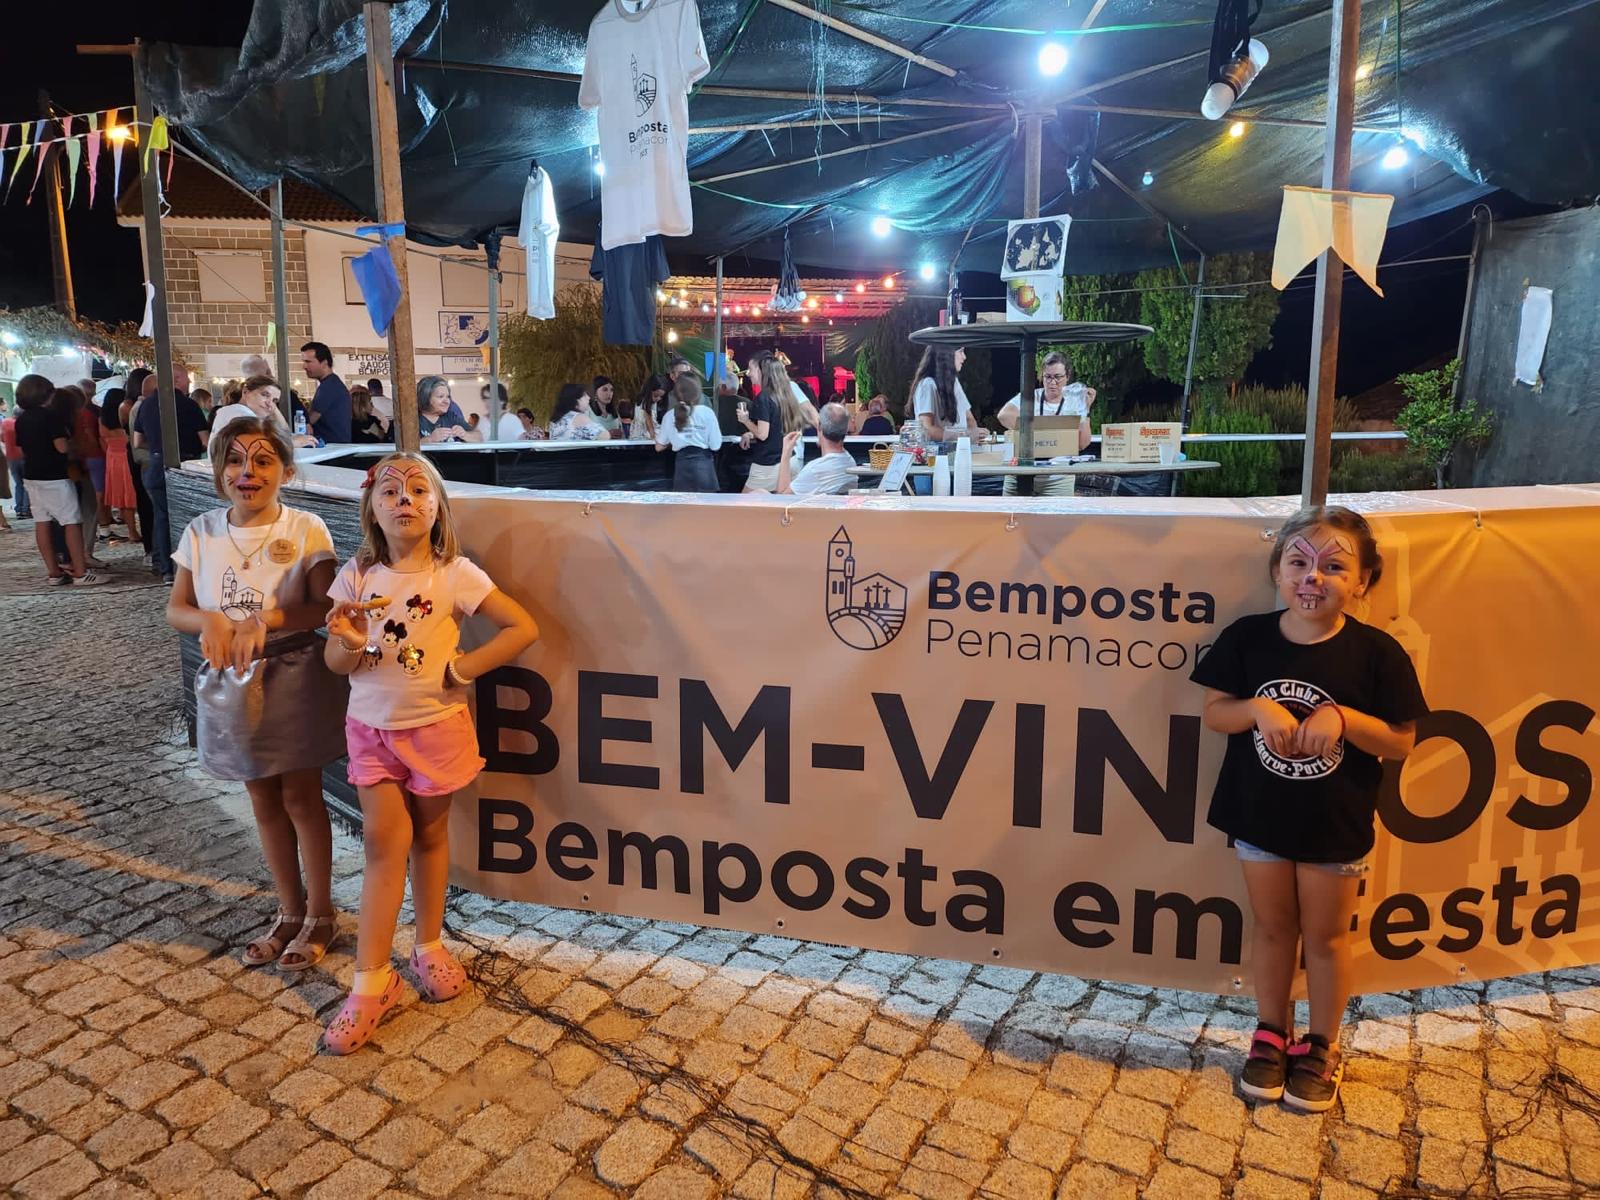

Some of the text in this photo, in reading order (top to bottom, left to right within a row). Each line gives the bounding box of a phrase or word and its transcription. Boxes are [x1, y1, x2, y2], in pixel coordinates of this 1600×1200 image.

[928, 571, 1216, 624] Bemposta
[928, 618, 1213, 670] Penamacor
[1280, 682, 1321, 703] Clube
[475, 664, 1597, 848] BEM-VINOS
[477, 798, 1582, 970] Bemposta em esta
